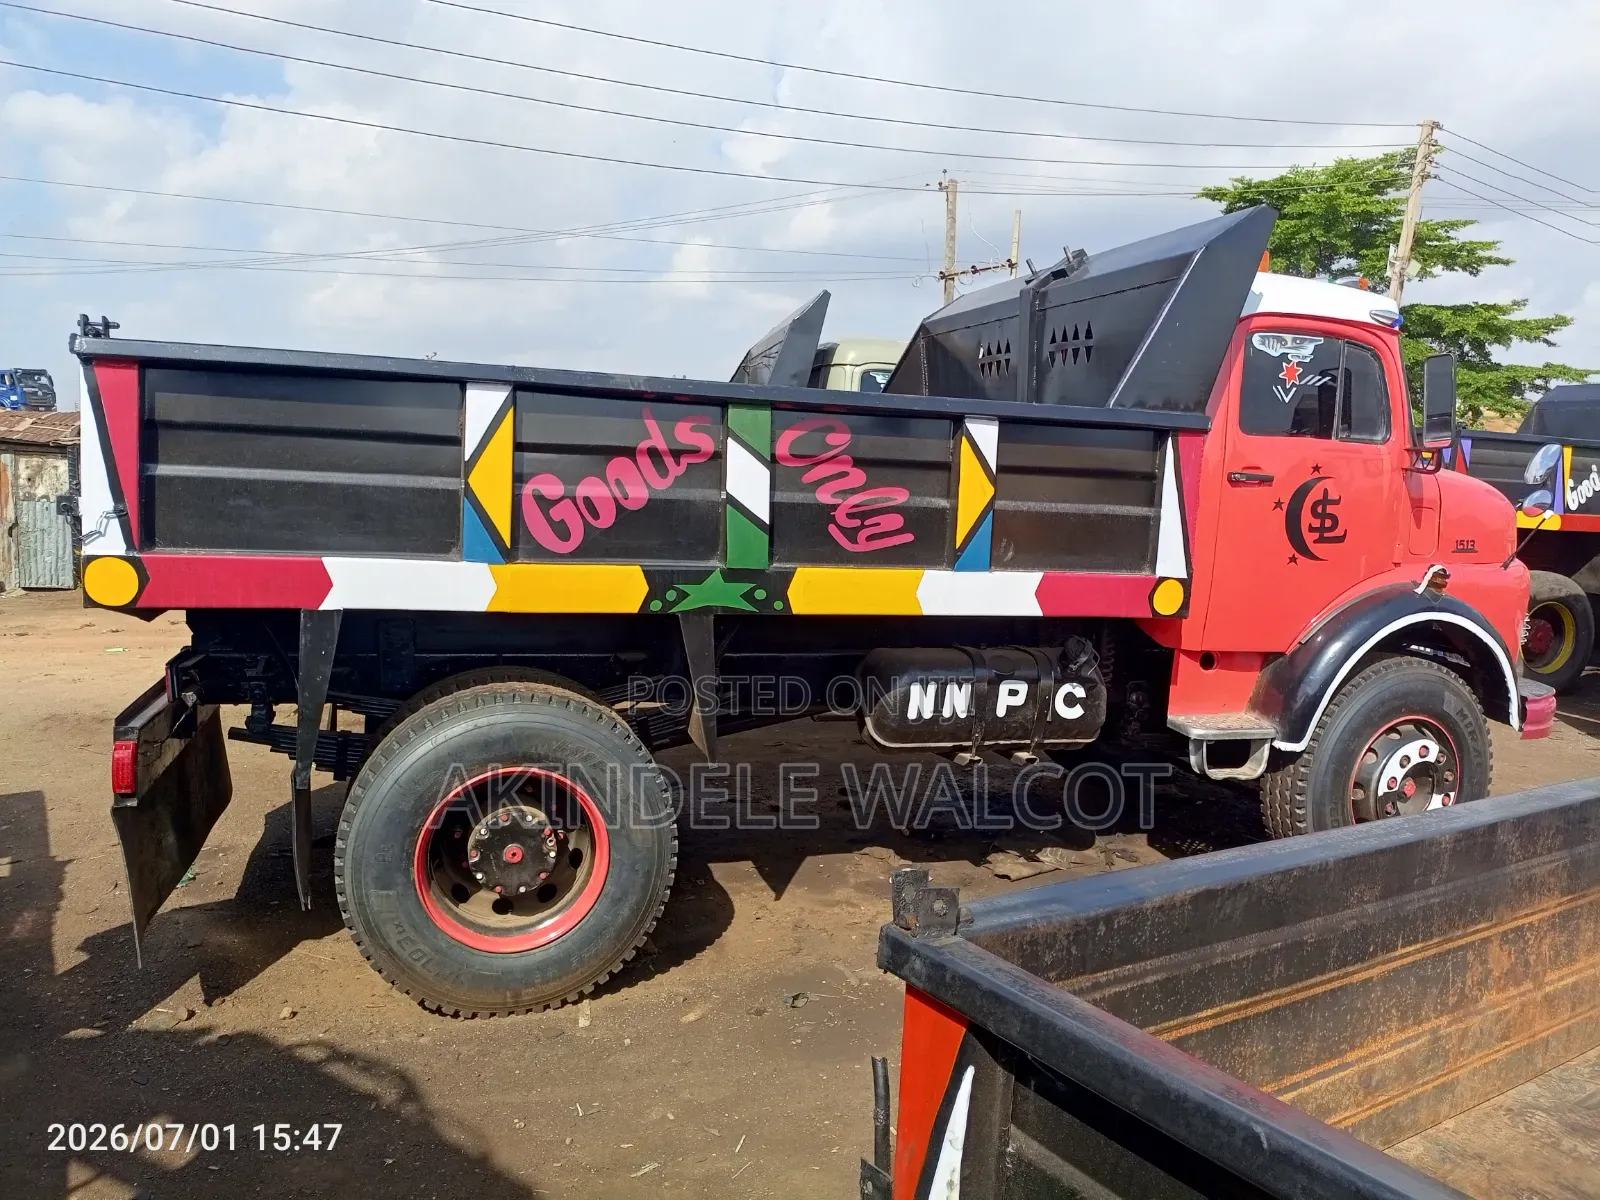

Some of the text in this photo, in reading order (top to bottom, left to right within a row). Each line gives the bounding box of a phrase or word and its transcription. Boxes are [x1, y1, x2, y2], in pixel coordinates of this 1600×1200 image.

[521, 407, 915, 555] Goods Only
[1455, 539, 1476, 550] 1513
